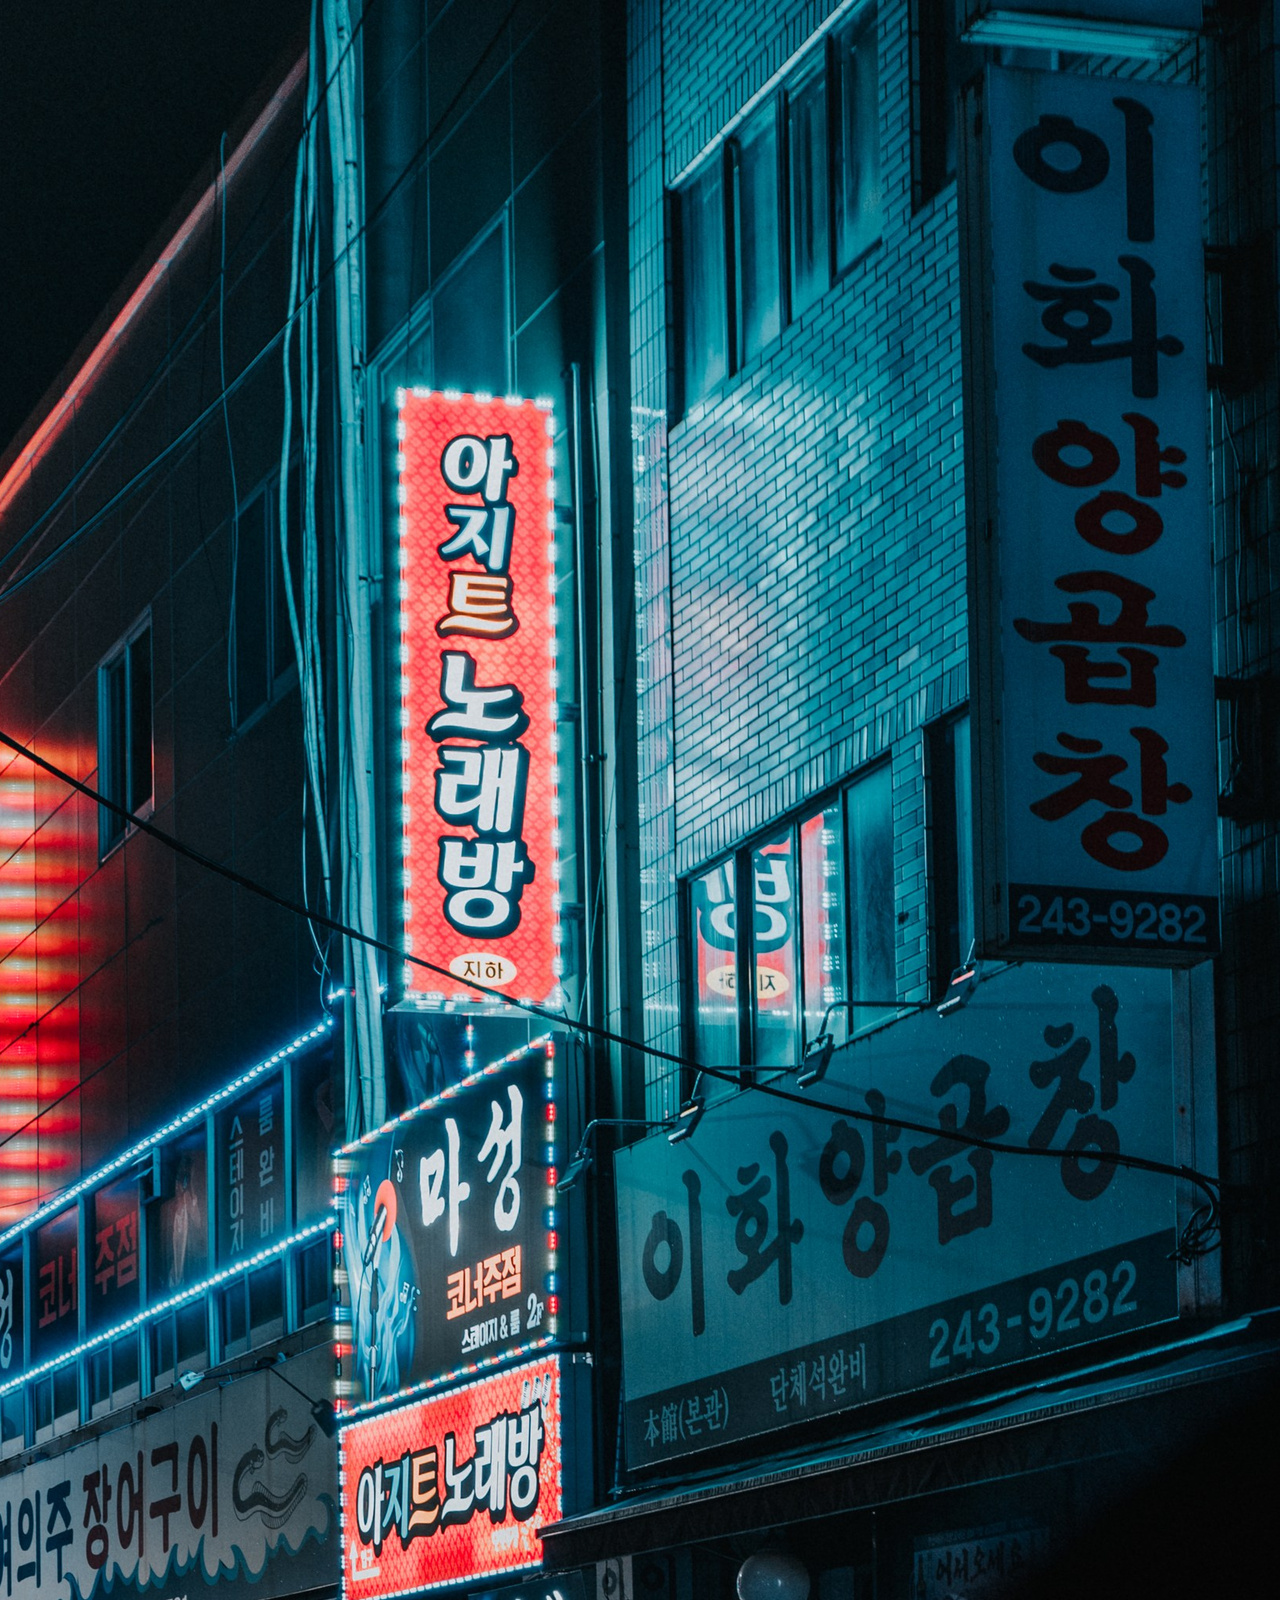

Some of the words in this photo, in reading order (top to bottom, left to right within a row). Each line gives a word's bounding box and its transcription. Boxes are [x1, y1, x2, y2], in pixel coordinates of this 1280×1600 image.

[1013, 96, 1192, 872] 이화양곱창
[1017, 893, 1207, 945] 243-9282
[463, 959, 504, 982] 지하
[420, 1084, 523, 1257] 마성
[642, 984, 1136, 1336] 이화양곱창
[446, 1244, 522, 1320] 코너주점
[526, 1292, 544, 1330] 2F
[927, 1260, 1138, 1370] 243-9282
[461, 1317, 498, 1354] 스테이지
[510, 1308, 520, 1336] 룸
[769, 1342, 867, 1414] 단체석완비
